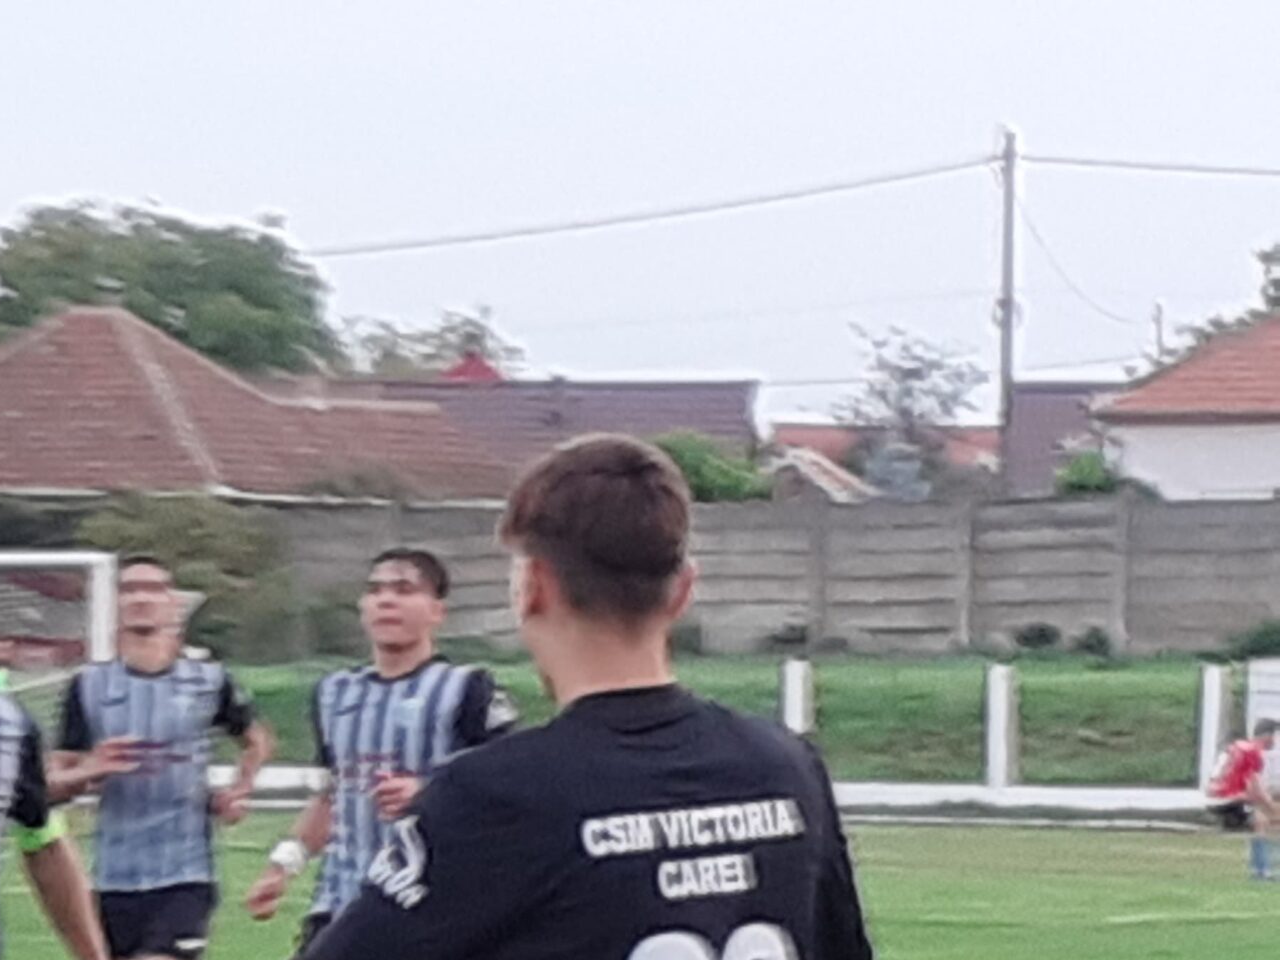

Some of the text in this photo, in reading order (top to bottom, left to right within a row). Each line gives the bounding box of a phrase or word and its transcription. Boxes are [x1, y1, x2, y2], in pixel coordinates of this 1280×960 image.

[582, 799, 803, 857] CSM VICTORIA
[658, 854, 756, 899] CAREI
